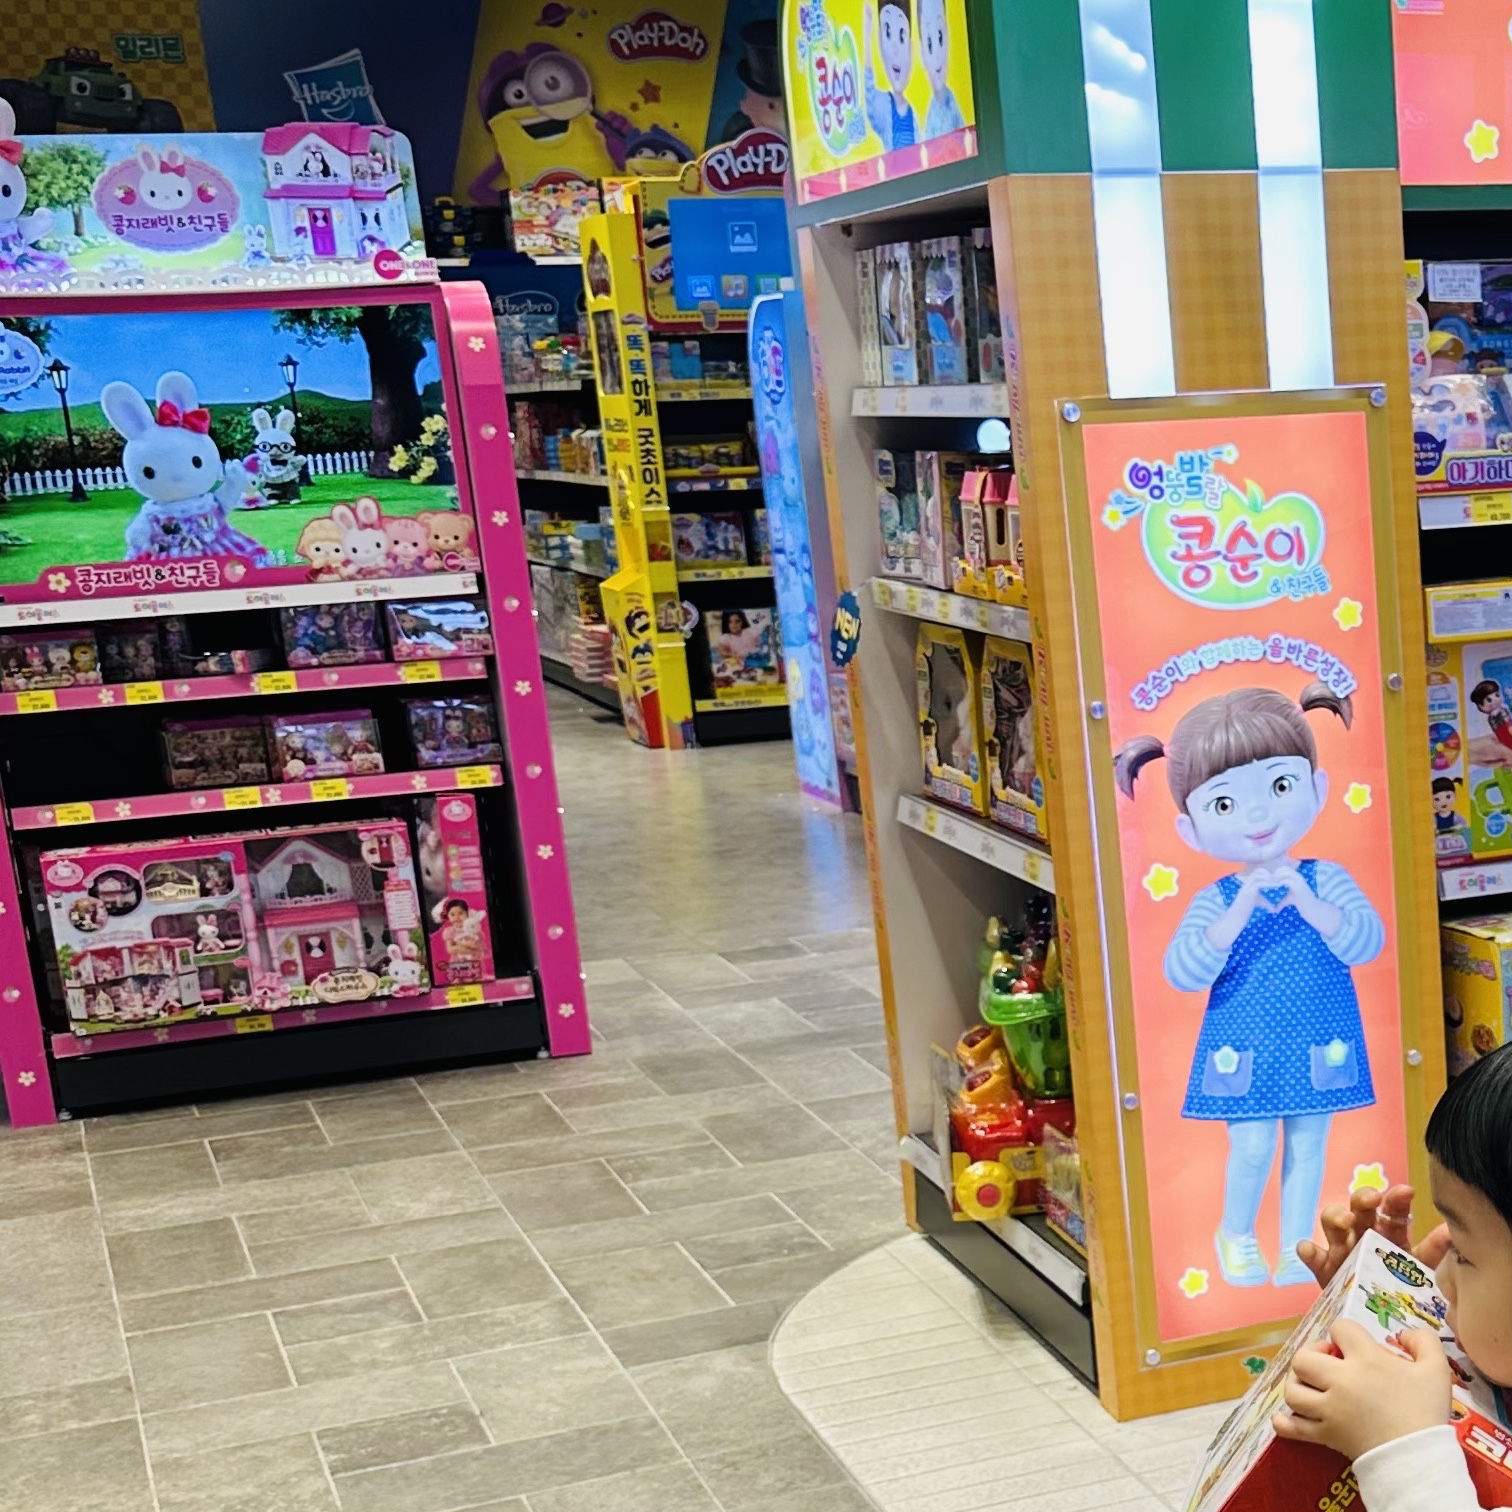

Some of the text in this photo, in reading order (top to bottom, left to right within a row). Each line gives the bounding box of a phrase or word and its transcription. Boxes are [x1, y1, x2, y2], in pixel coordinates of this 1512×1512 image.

[609, 20, 705, 56] Play-Doh
[298, 80, 373, 106] Hasbro
[110, 211, 231, 236] 콩지래빗&친구들
[496, 296, 554, 316] Hasbro
[1129, 453, 1227, 508] 엉뚱발랄
[1169, 513, 1306, 589] 콩순이
[75, 560, 221, 595] 콩지래빗&친구들
[1269, 564, 1330, 600] & 친구들
[1129, 654, 1199, 710] 콩순이와
